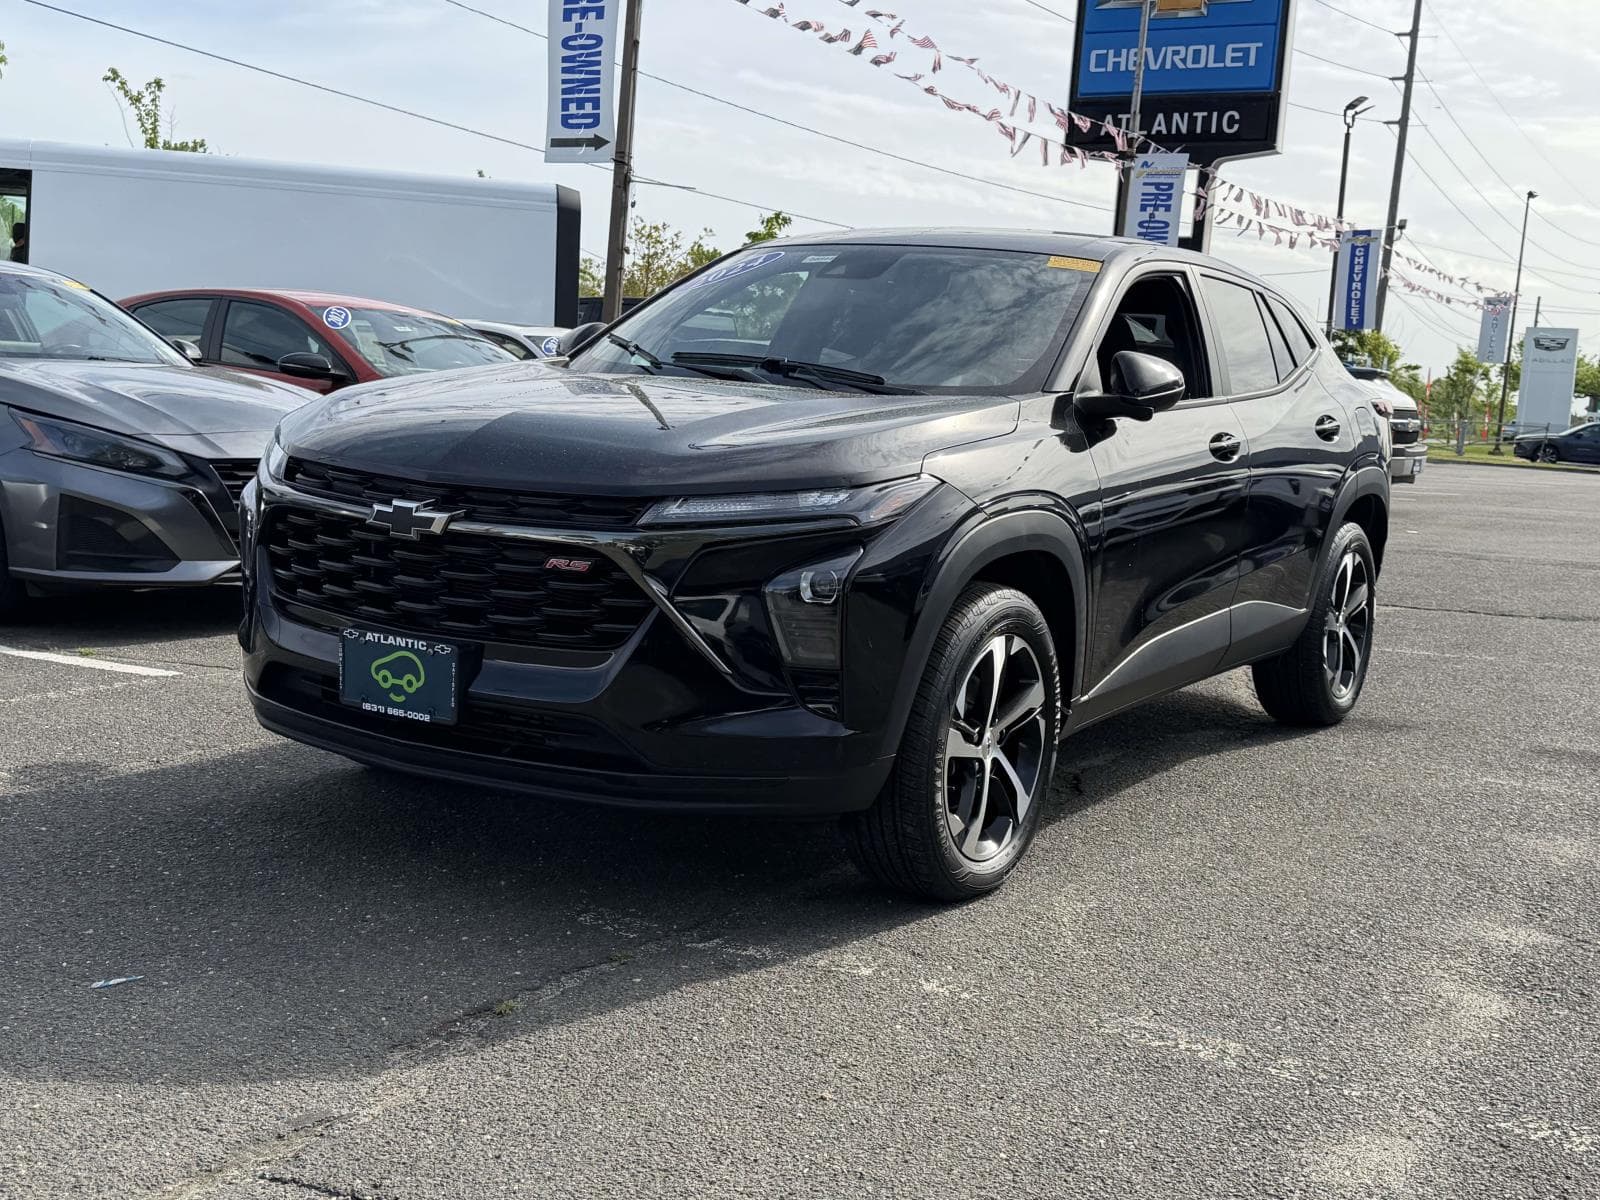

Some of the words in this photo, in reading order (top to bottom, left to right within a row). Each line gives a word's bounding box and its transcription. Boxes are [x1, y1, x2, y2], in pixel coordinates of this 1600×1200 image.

[1089, 42, 1263, 73] CHEVROLET
[1100, 110, 1241, 137] ATLANTIC
[1350, 247, 1365, 325] CHEVROLET
[545, 558, 592, 572] RS
[365, 632, 427, 650] ATLANTIC
[362, 702, 385, 714] (631)
